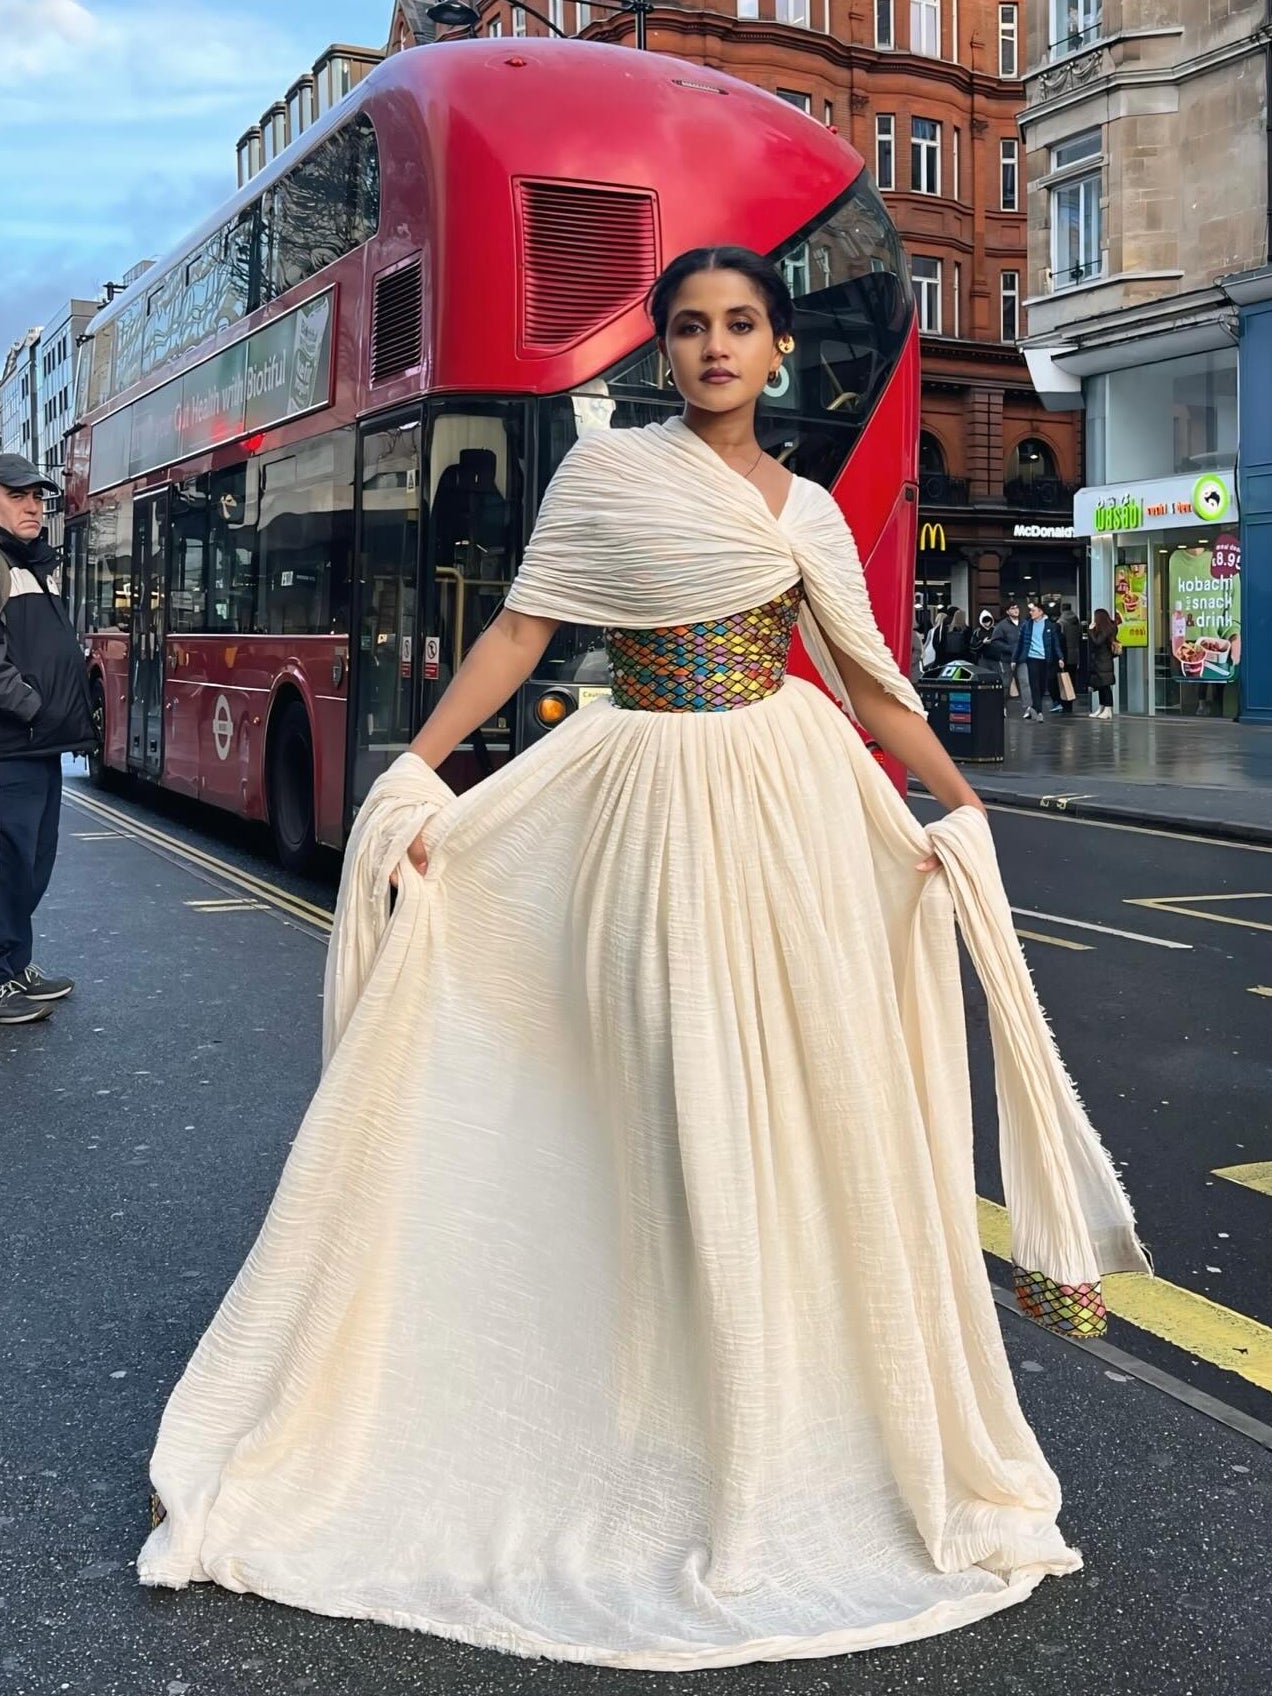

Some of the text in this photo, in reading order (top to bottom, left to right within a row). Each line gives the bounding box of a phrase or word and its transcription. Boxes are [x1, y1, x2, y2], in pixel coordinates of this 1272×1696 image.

[222, 373, 243, 411] with
[247, 349, 286, 400] Biotiful
[1013, 524, 1075, 538] McDonald'
[1178, 574, 1233, 593] kobachi
[1192, 591, 1232, 610] snack
[1196, 611, 1232, 628] drink
